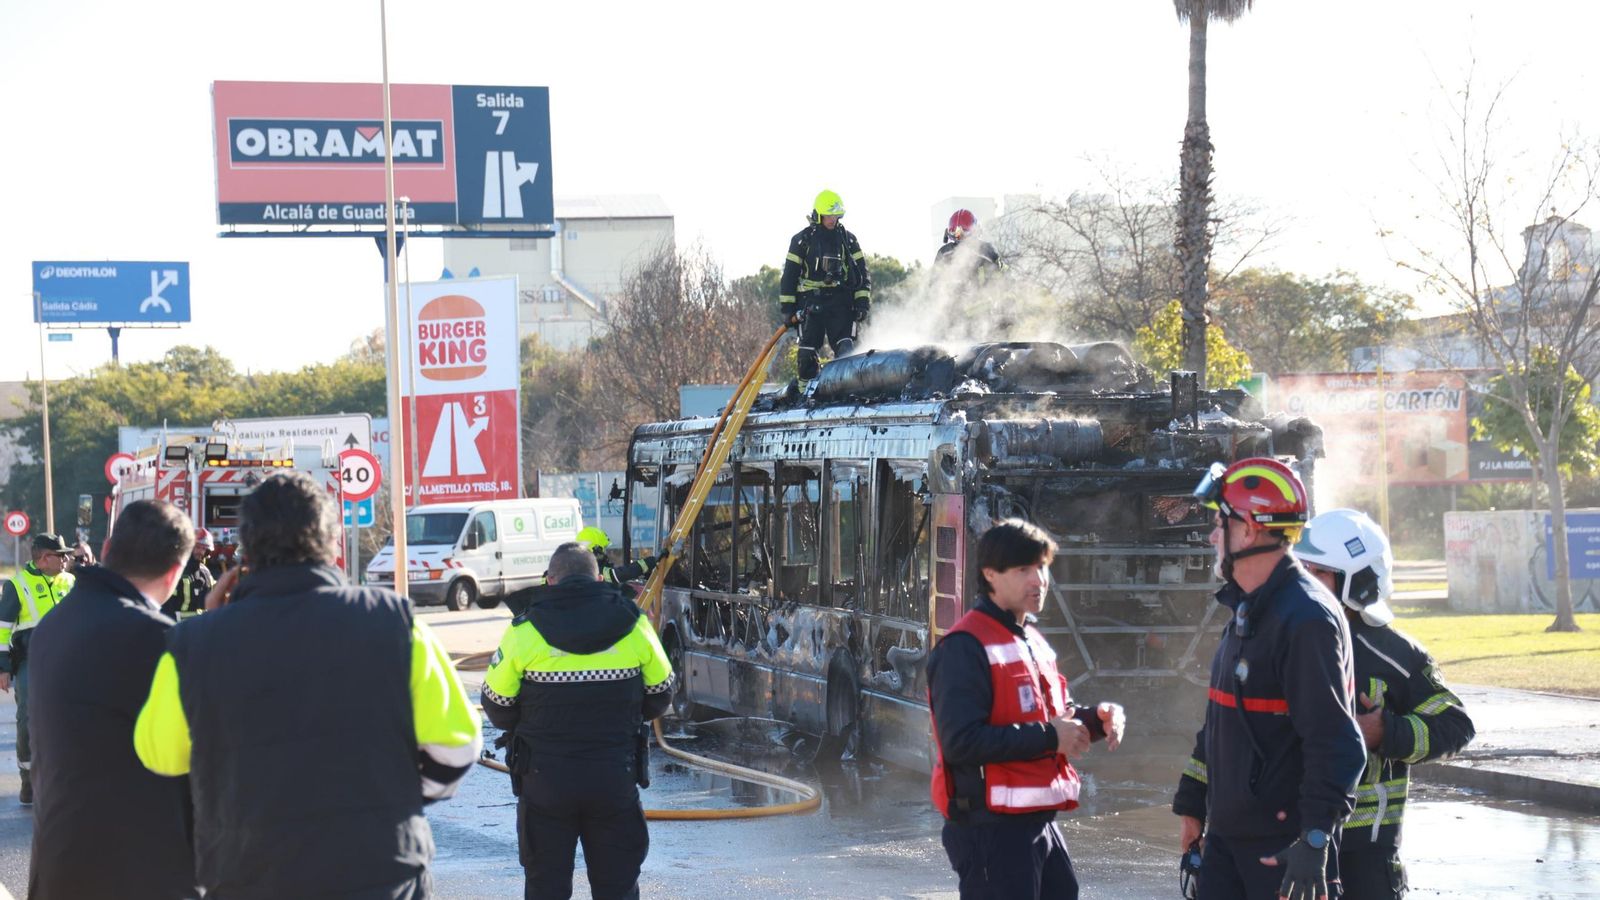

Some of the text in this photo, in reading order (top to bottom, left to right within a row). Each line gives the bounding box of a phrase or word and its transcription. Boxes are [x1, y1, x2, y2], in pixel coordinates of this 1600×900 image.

[476, 93, 525, 108] Salida
[491, 111, 510, 135] 7
[235, 126, 438, 158] OBRAMAT
[263, 204, 415, 220] Alcalá de Guadíra
[418, 320, 487, 340] BURGER
[418, 338, 487, 366] KING
[472, 395, 486, 416] 3
[1384, 384, 1463, 412] CARTÓN
[279, 426, 339, 437] Residencial
[343, 467, 369, 483] 40
[417, 483, 472, 496] ALMETILLO
[9, 519, 24, 528] 40
[544, 513, 574, 529] Casal
